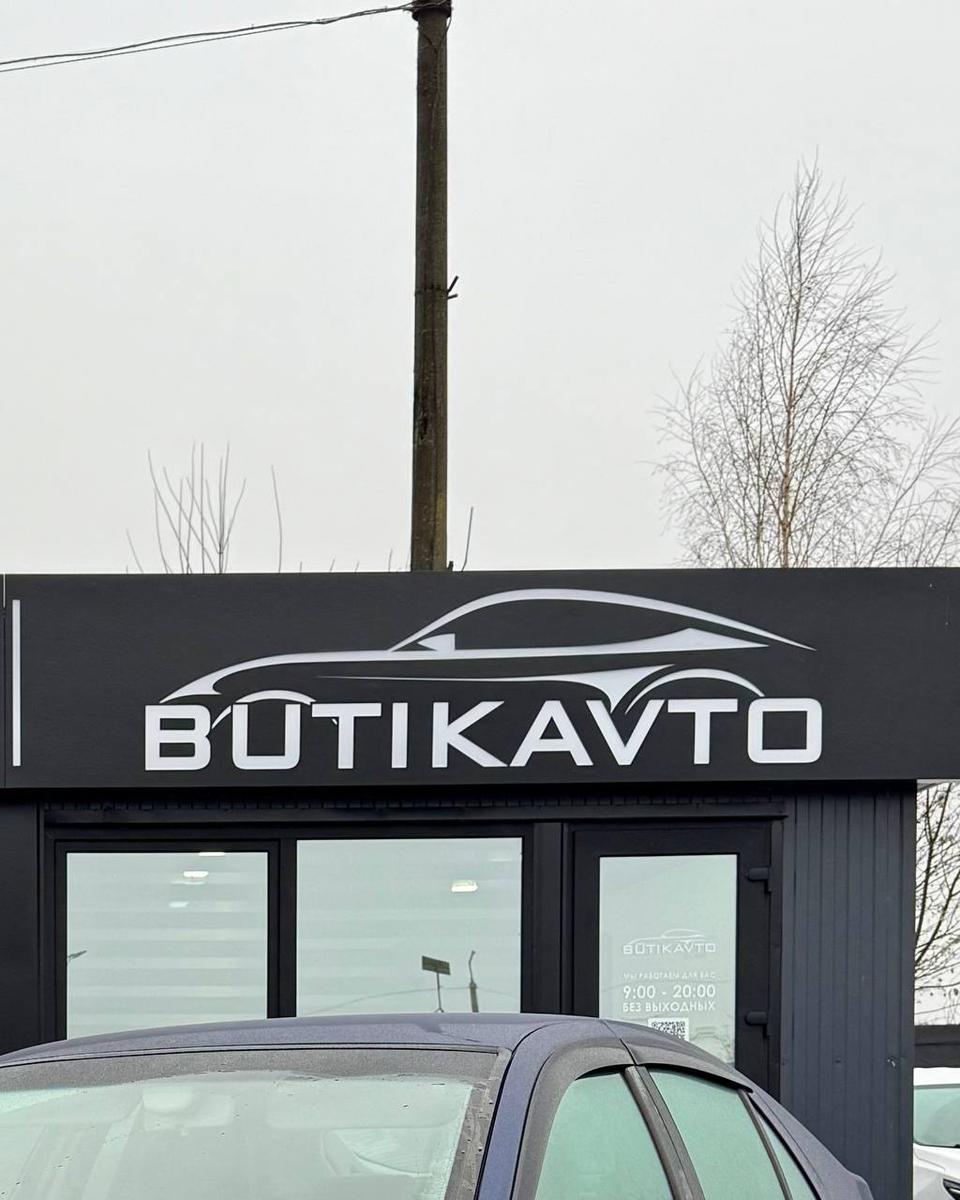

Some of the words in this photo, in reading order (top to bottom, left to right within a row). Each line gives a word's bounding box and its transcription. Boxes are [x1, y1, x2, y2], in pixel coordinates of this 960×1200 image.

[144, 698, 824, 772] BUTIKAVTO
[623, 943, 717, 955] BUTIKAVTO
[623, 985, 656, 999] 9:00
[673, 984, 716, 998] 20:00
[623, 1002, 641, 1012] БЕЗ
[646, 1001, 716, 1012] ВЫХОДНЫХ
